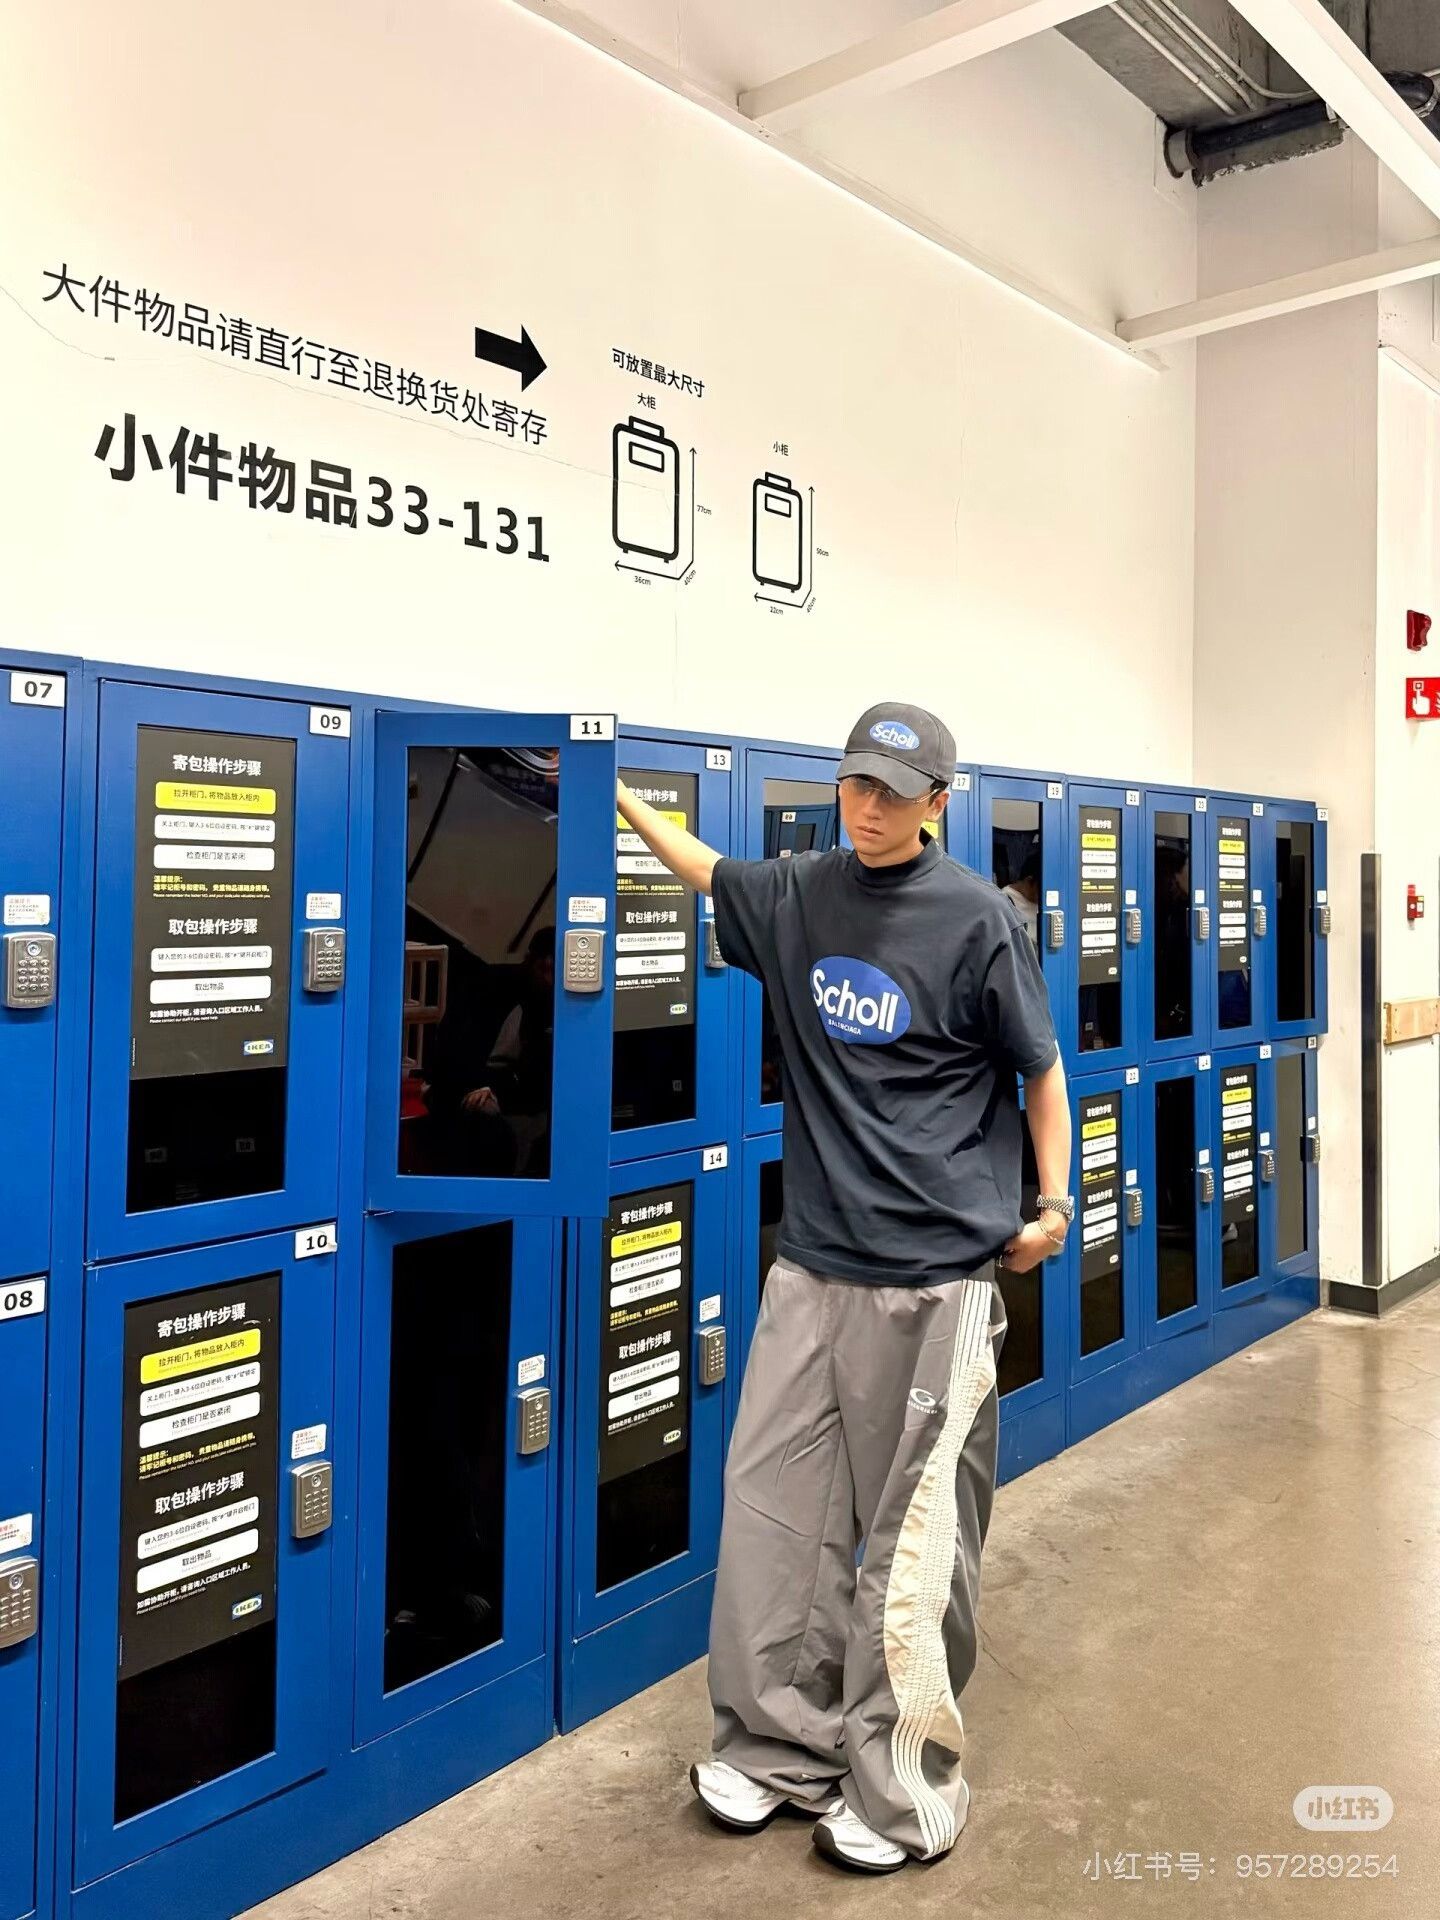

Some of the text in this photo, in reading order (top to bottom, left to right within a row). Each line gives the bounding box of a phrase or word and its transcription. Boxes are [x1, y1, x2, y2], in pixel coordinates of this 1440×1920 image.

[42, 263, 548, 445] 大件物品请直行至退换货处寄存
[612, 348, 705, 398] 可放置最大尺寸
[637, 393, 656, 410] 大柜
[773, 441, 789, 457] 小柜
[95, 412, 550, 563] 小件物品33-131
[697, 505, 712, 516] 77cm
[634, 575, 651, 586] 36cm
[23, 680, 53, 699] 07
[319, 714, 342, 731] 09
[581, 721, 603, 735] 11
[873, 724, 916, 748] Scholl
[172, 754, 262, 777] 寄包操作步骤
[713, 754, 726, 766] 13
[957, 777, 966, 787] 17
[186, 851, 246, 861] 检查柜门是否紧闭
[625, 911, 677, 924] 取包操作步骤
[168, 918, 258, 935] 取包操作步骤
[194, 982, 225, 991] 取出物品
[813, 968, 899, 1034] Scholl
[828, 1018, 862, 1036] BALENCIAGA
[709, 1152, 723, 1166] 14
[620, 1201, 674, 1225] 寄包操作步骤
[306, 1234, 328, 1251] 10
[4, 1290, 33, 1311] 08
[157, 1302, 247, 1339] 寄包操作步骤
[618, 1330, 672, 1360] 取包操作步骤
[171, 1404, 232, 1430] 检查柜门是否紧闭
[154, 1471, 244, 1514] 取包操作步骤
[181, 1549, 212, 1567] 取出物品
[235, 1600, 260, 1614] IKEA
